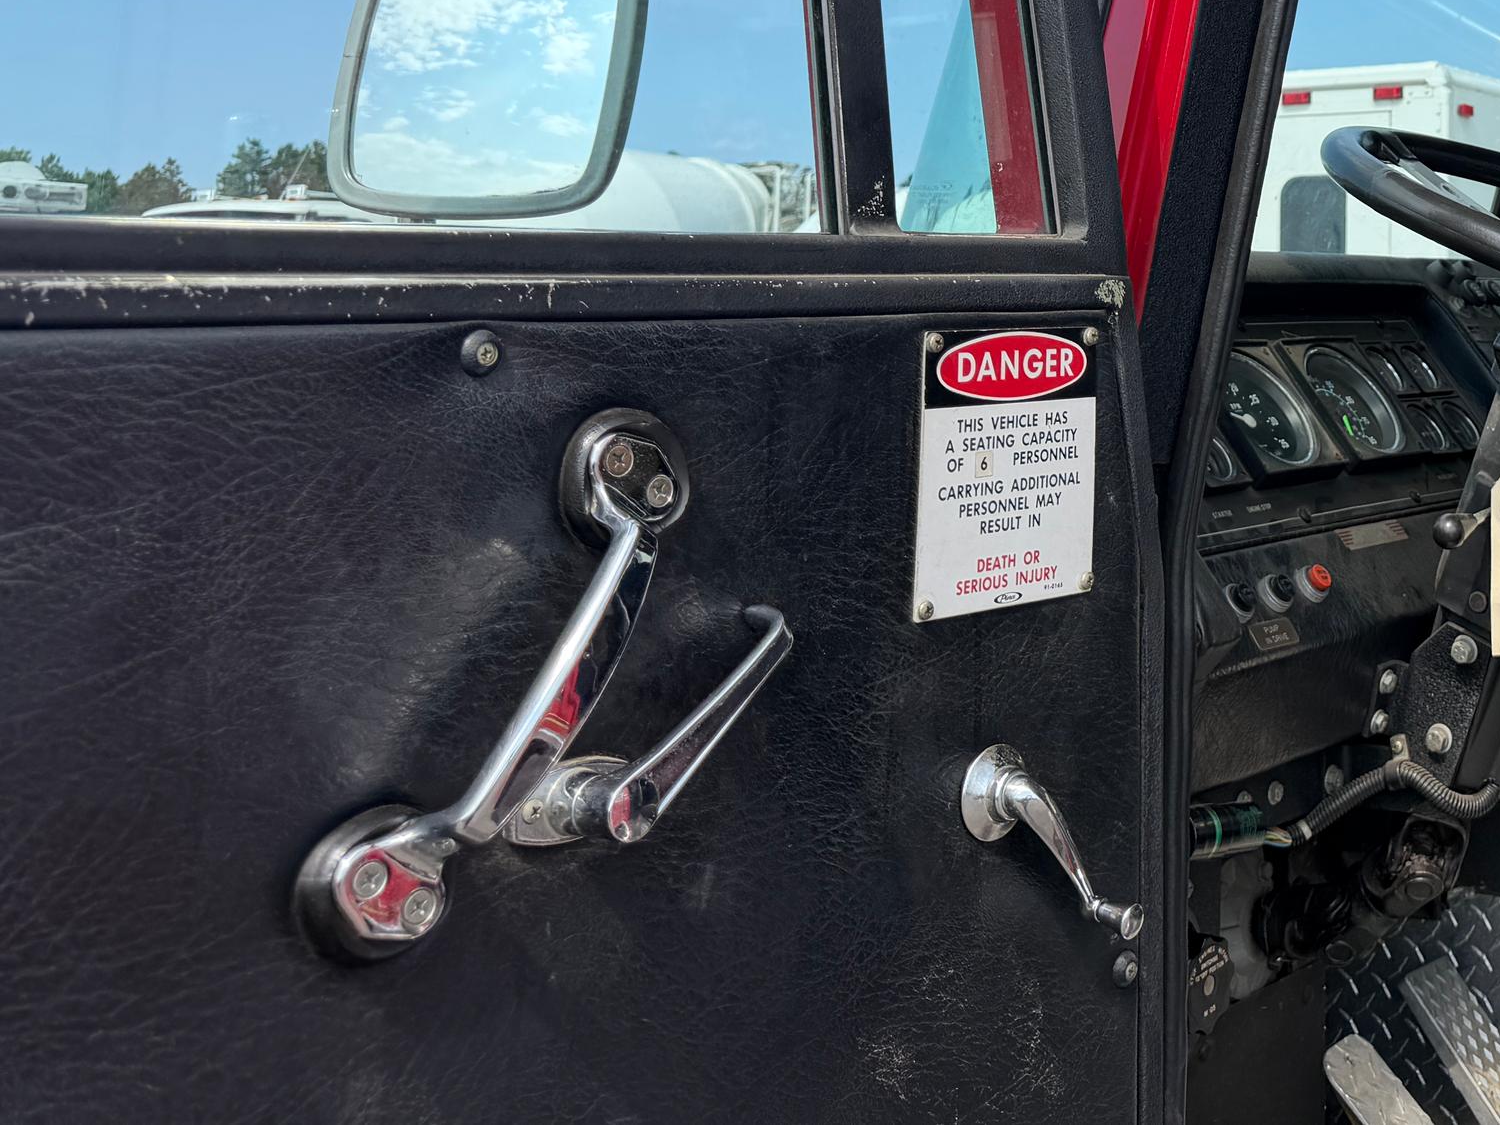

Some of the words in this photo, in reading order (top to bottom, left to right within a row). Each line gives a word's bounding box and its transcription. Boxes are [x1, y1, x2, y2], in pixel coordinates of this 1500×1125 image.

[957, 348, 1074, 383] DANGER
[957, 416, 984, 433] THIS
[991, 413, 1038, 431] VEHICLE
[1045, 411, 1068, 425] HAS
[945, 440, 954, 454] A
[962, 433, 1015, 452] SEATING
[1022, 428, 1077, 446] CAPACITY
[947, 457, 964, 473] OF
[980, 456, 988, 471] 6
[1013, 446, 1078, 466] PERSONNEL
[938, 480, 1003, 501] CARRYING
[1011, 471, 1080, 492] ADDITIONAL
[959, 496, 1029, 518] PERSONNEL
[1035, 492, 1062, 508] MAY
[980, 516, 1020, 534] RESULT
[1028, 513, 1041, 527] IN
[977, 553, 1016, 573] DEATH
[1023, 550, 1040, 565] OR
[956, 574, 1008, 596] SERIOUS
[1015, 565, 1058, 585] INJURY
